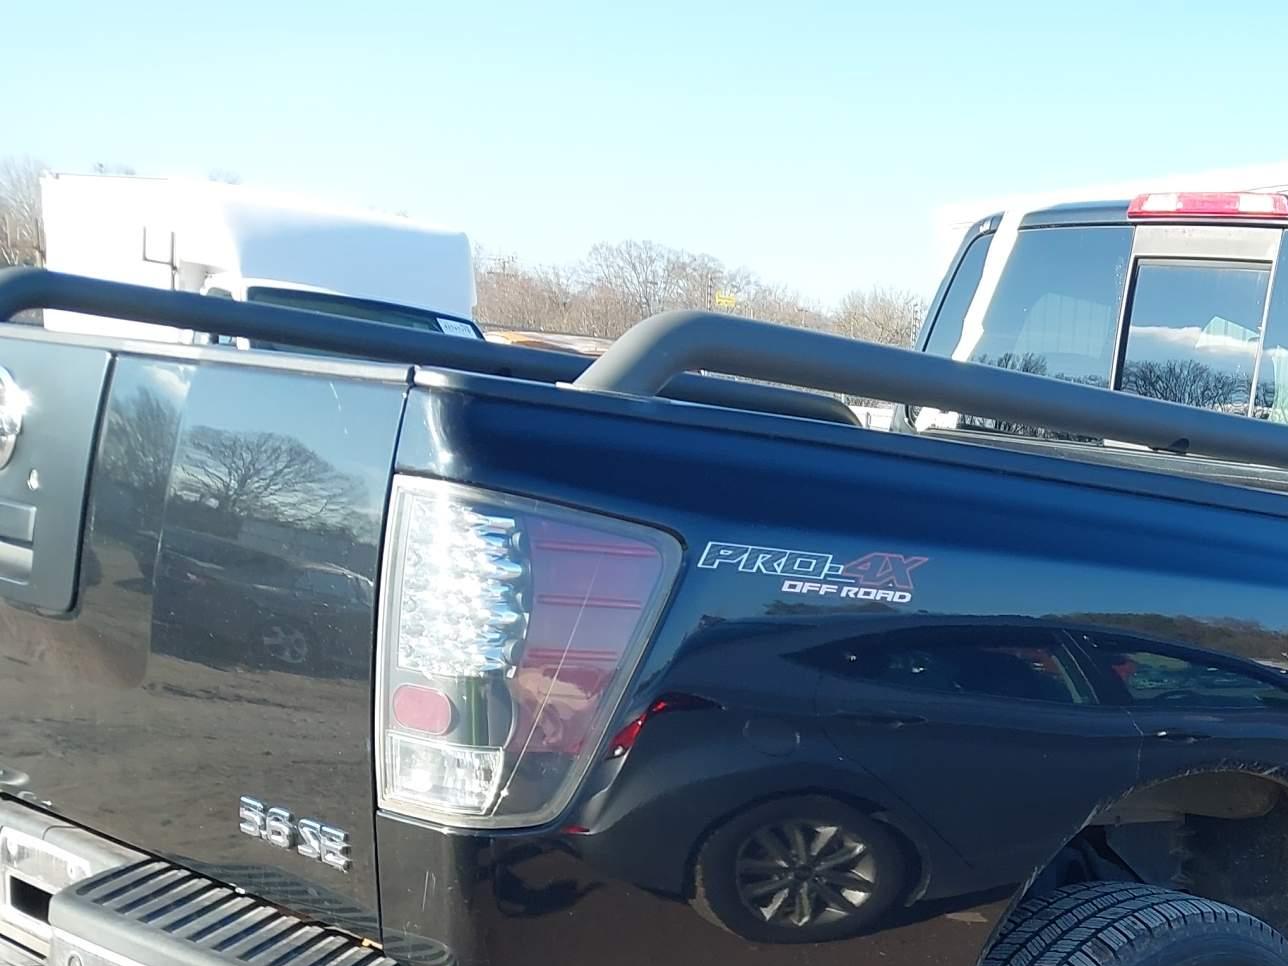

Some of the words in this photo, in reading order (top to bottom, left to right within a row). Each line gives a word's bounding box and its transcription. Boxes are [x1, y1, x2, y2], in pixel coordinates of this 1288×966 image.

[781, 579, 839, 596] OFF
[840, 586, 913, 603] ROAD
[297, 818, 352, 873] SE
